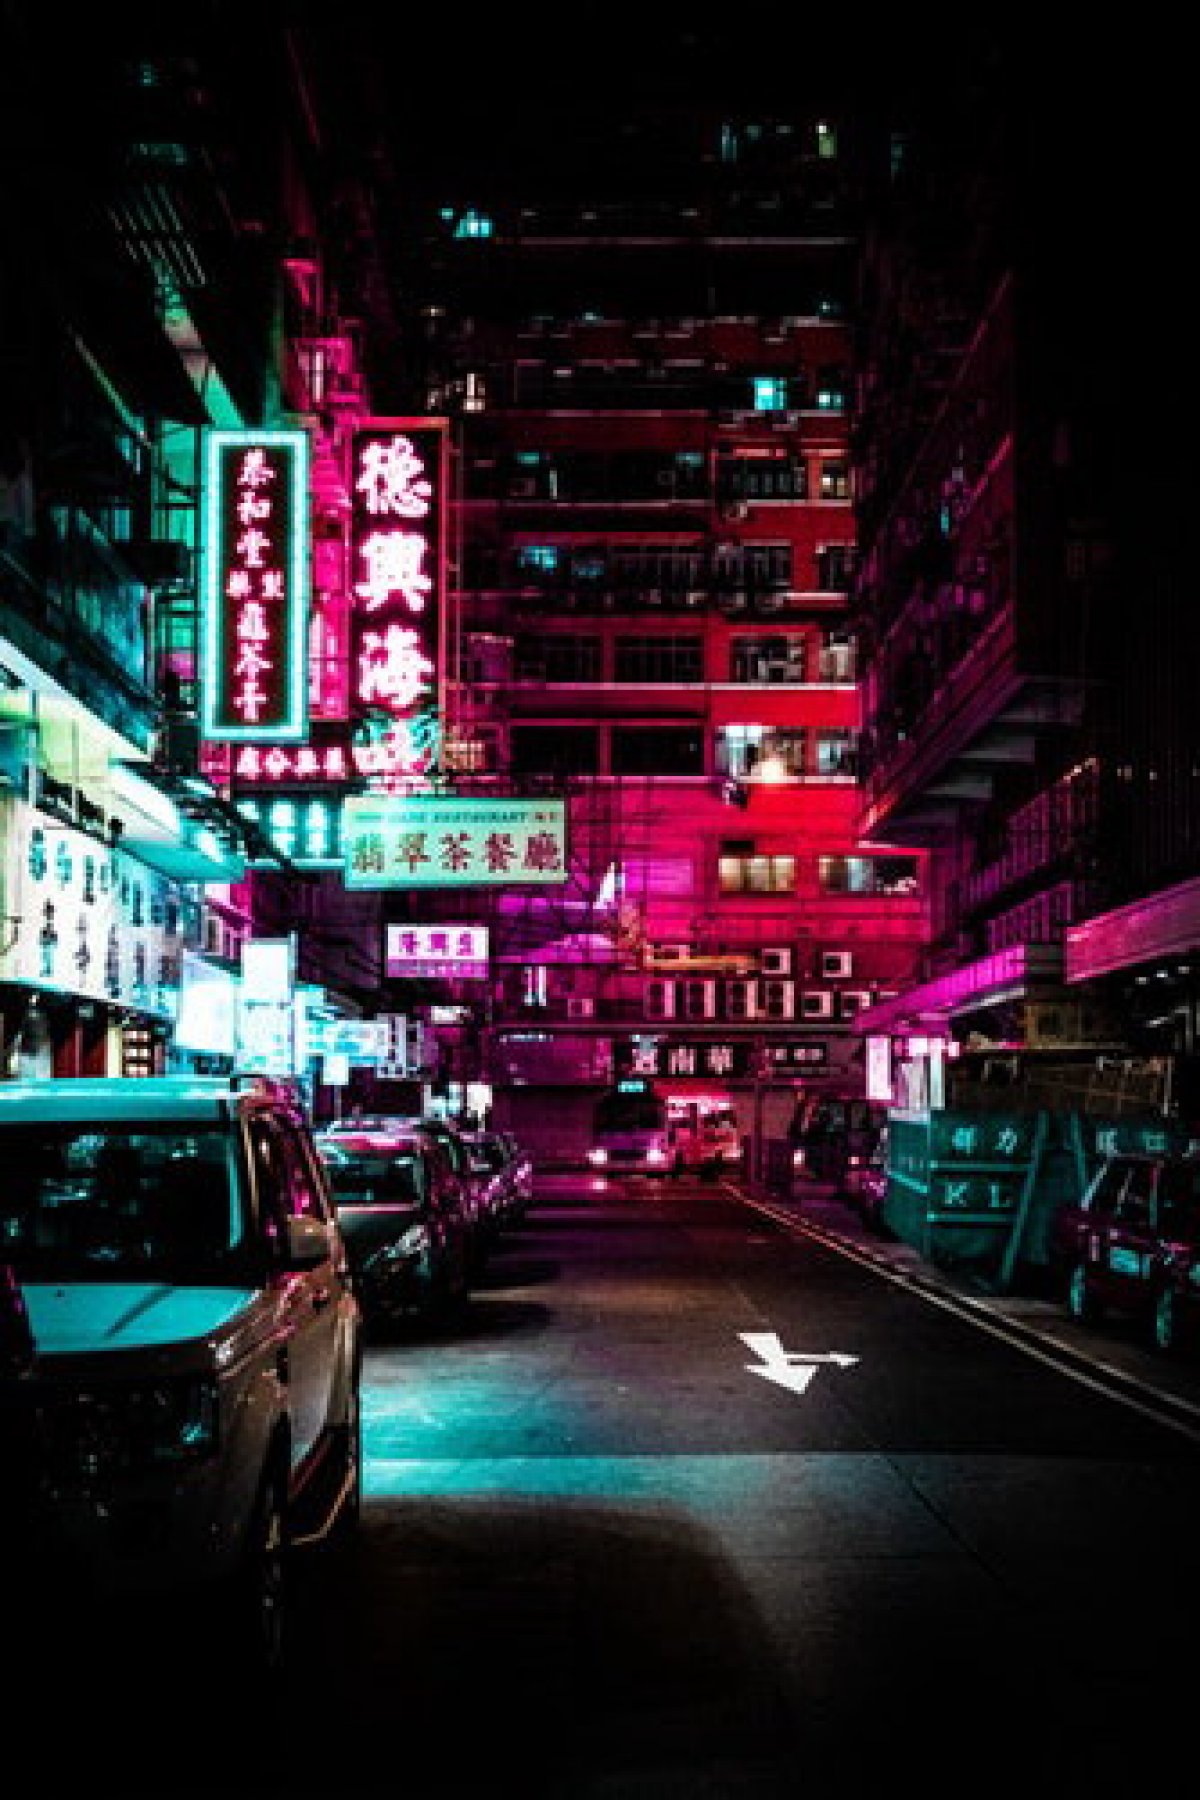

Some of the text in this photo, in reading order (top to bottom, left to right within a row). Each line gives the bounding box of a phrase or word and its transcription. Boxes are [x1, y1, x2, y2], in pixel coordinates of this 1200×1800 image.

[350, 832, 562, 873] 翡翠茶餐廳
